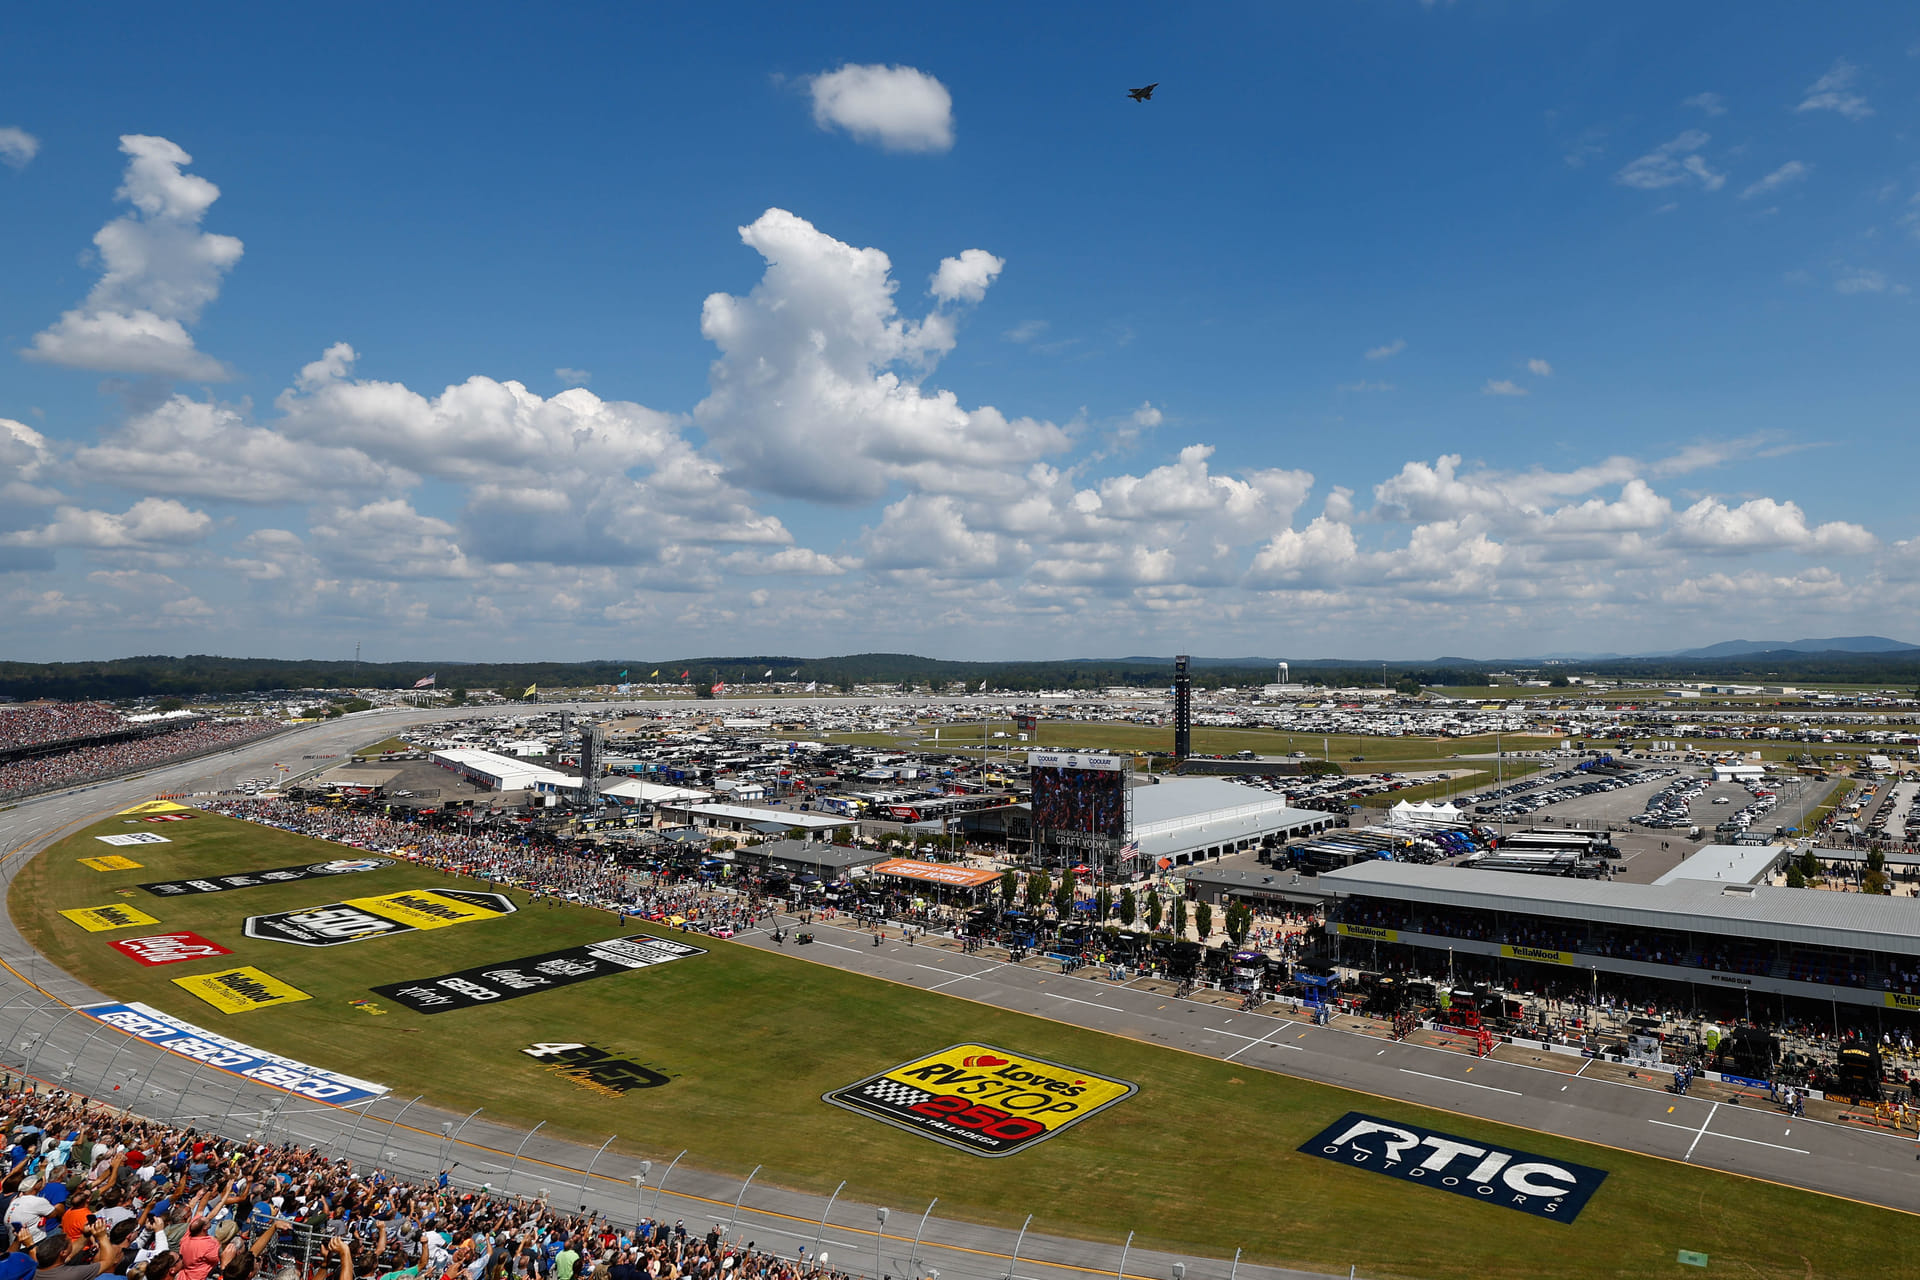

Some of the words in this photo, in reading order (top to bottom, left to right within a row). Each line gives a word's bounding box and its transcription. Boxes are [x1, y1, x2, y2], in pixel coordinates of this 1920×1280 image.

[1055, 835, 1080, 847] CRAFT
[1082, 838, 1110, 849] VODKA
[887, 866, 926, 876] CRAFT
[924, 871, 967, 882] VODKA
[282, 908, 396, 938] 500
[1346, 924, 1387, 937] YellaWood
[1511, 946, 1560, 960] YellaWood
[213, 972, 285, 1003] YellaWood
[436, 977, 502, 1000] GEICO
[98, 1011, 177, 1038] GEICO
[157, 1014, 252, 1052] RESTART
[160, 1037, 253, 1067] GEICO
[242, 1065, 351, 1098] GEICO
[907, 1095, 1047, 1140] 250
[925, 1119, 1000, 1146] TALLADEGA
[1332, 1120, 1577, 1197] RTIC
[1323, 1145, 1559, 1212] OUTDOORS
